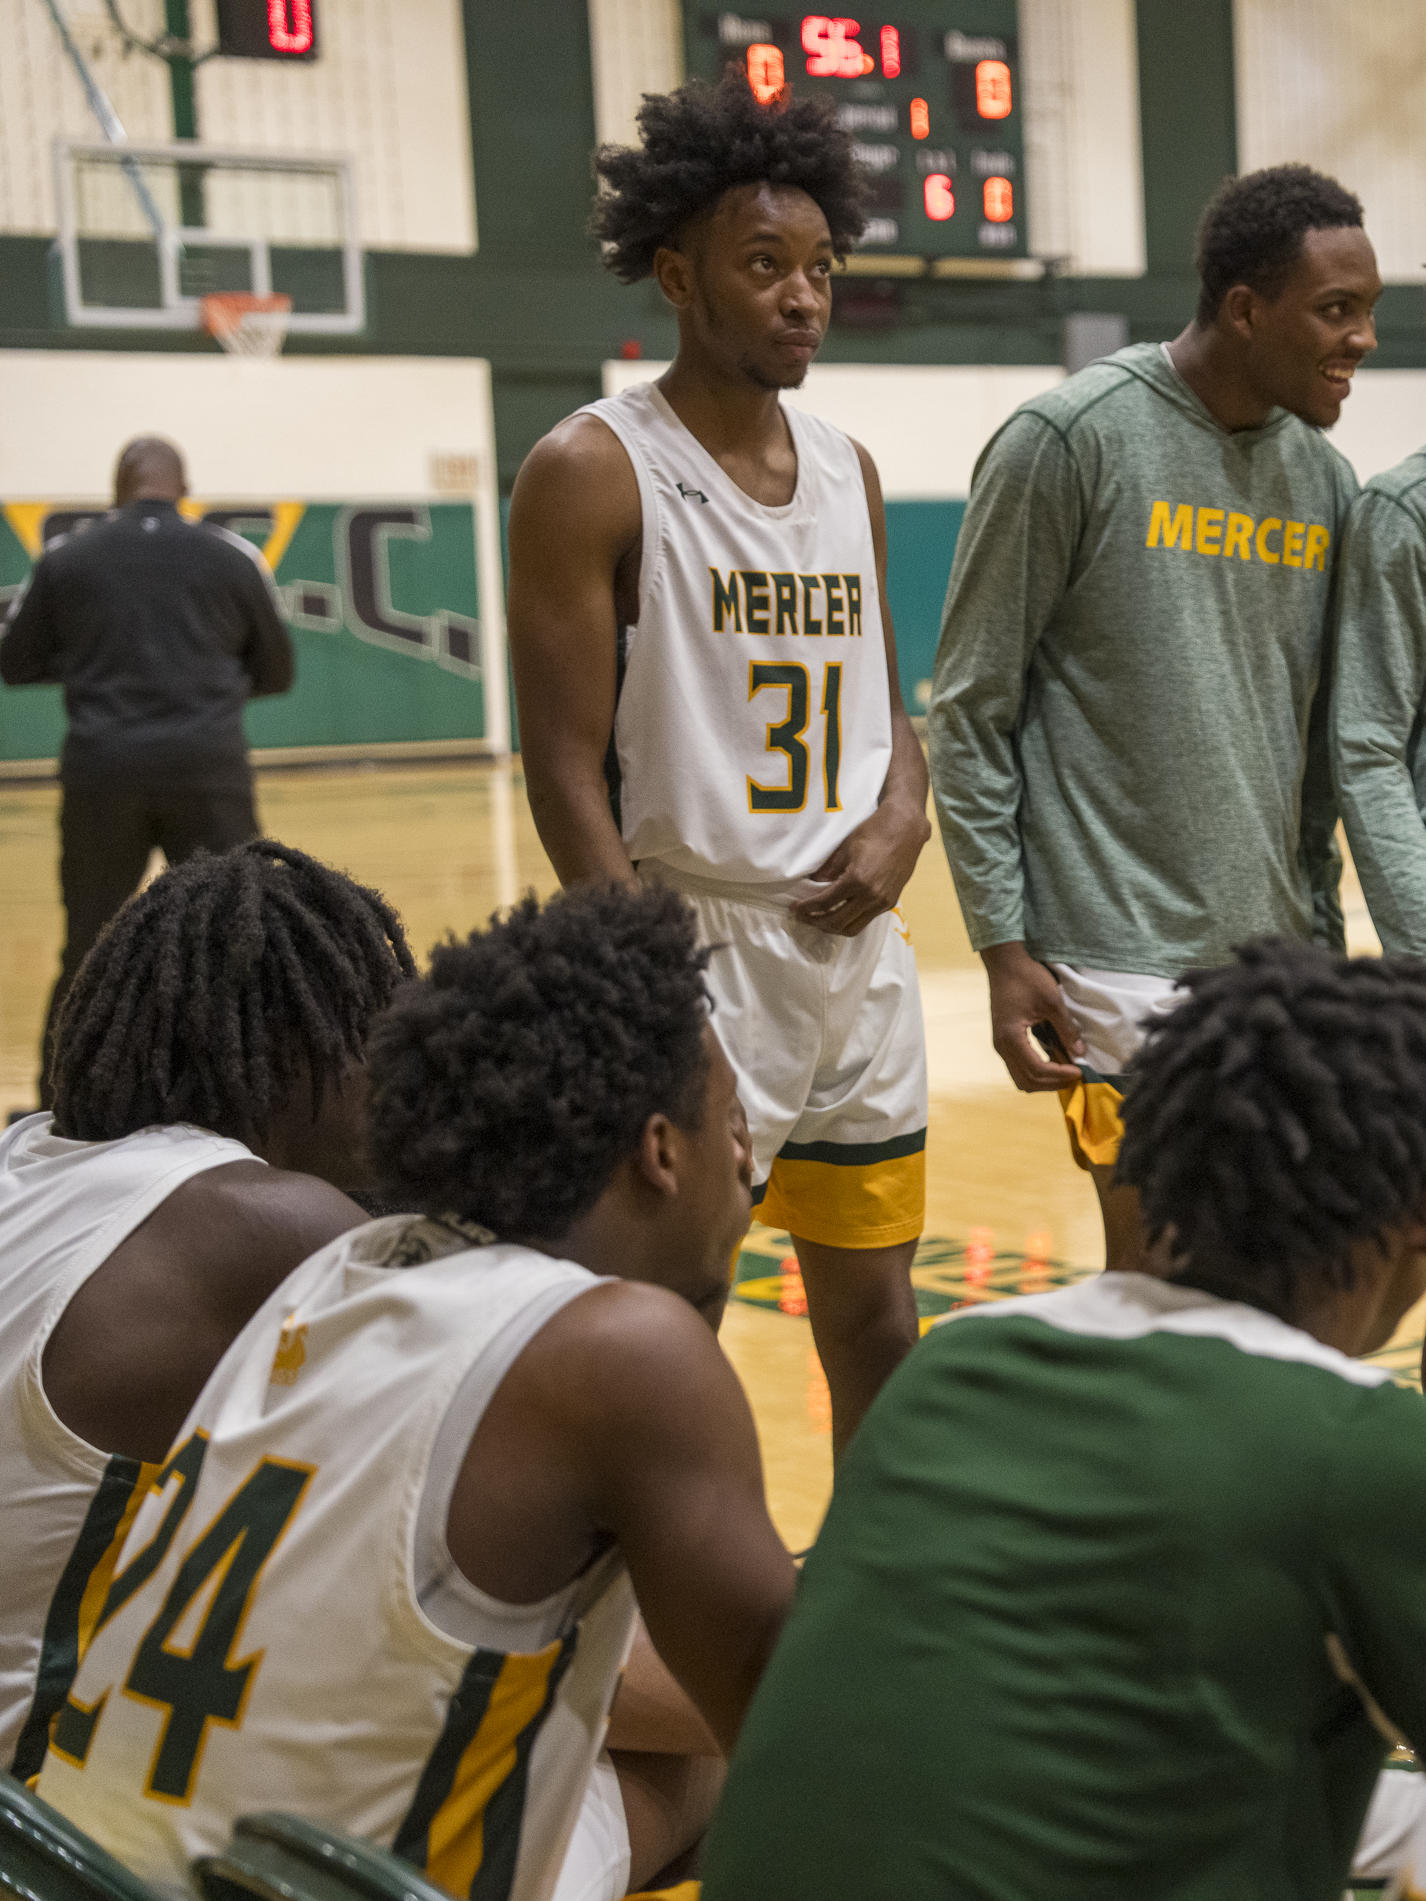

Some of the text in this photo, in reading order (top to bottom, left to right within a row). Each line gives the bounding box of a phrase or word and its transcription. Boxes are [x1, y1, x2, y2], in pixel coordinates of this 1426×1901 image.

[910, 98, 930, 140] 1
[976, 60, 1012, 119] 0
[924, 174, 955, 221] 6
[1146, 500, 1330, 572] MERCER
[709, 567, 862, 637] MERCER
[746, 660, 843, 814] 31
[49, 1427, 318, 1808] 24
